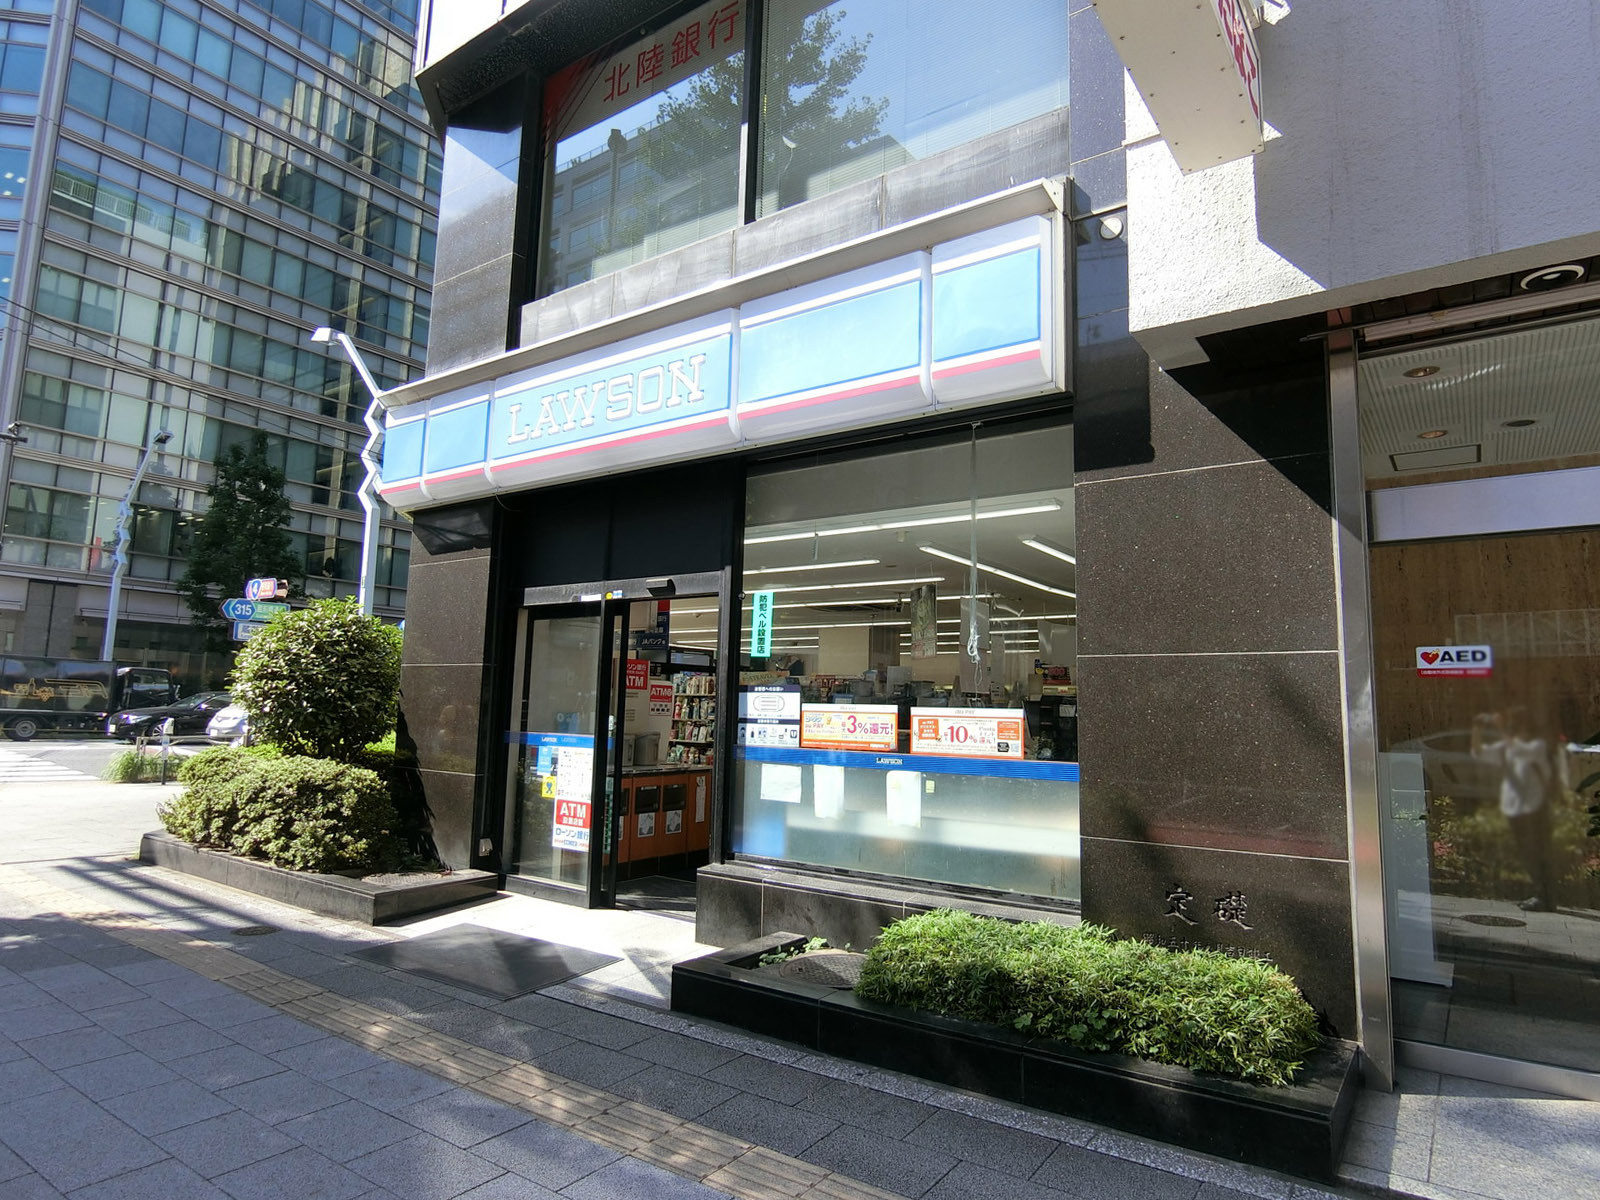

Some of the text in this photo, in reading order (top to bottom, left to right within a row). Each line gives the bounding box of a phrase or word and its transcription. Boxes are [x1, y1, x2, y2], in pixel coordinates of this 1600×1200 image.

[603, 1, 741, 103] 北陸銀行
[507, 353, 706, 446] LAWSON
[234, 604, 252, 616] 315
[756, 594, 769, 655] 防犯ベル設置店
[1440, 650, 1487, 662] AED
[875, 757, 903, 765] LAWSON
[560, 802, 587, 818] ATM
[555, 827, 590, 841] ローソン銀行
[1163, 882, 1254, 930] 定礎
